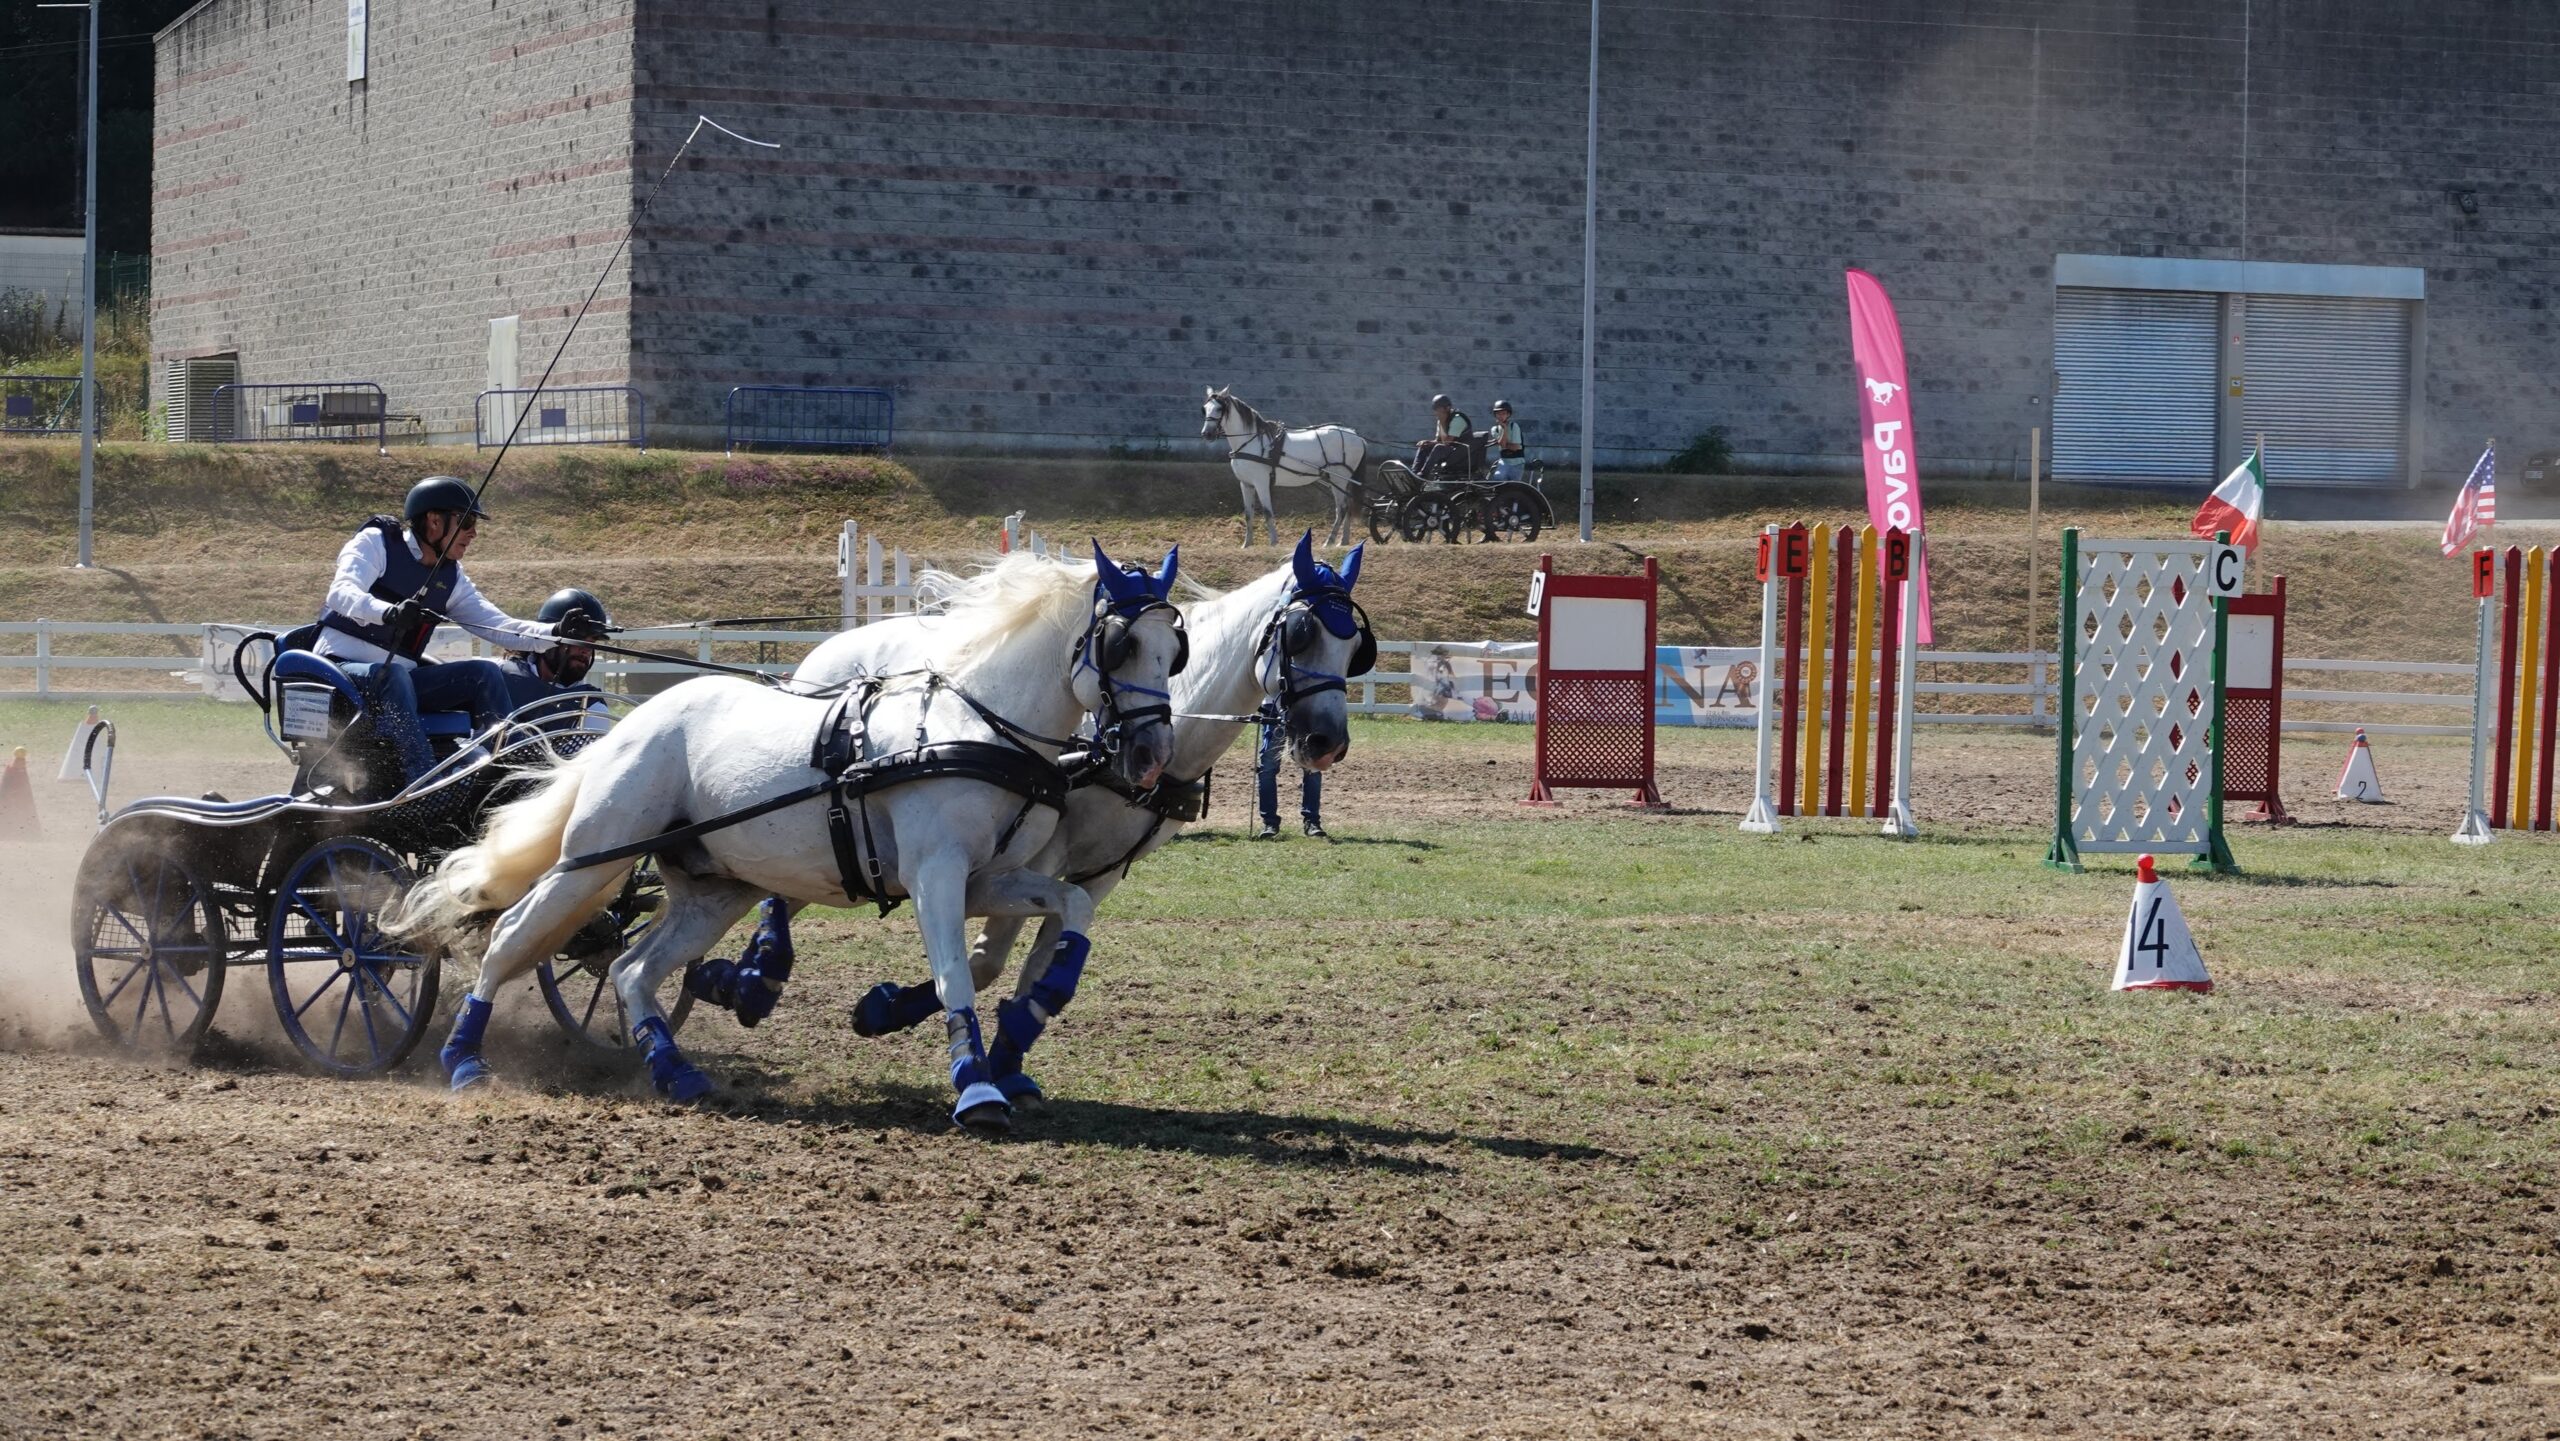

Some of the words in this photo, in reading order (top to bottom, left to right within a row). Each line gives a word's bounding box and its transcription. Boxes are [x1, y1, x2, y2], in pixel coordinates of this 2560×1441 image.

[839, 538, 847, 571] A
[1787, 534, 1803, 573] E
[1890, 539, 1905, 576] B
[2216, 549, 2238, 591] C
[1531, 577, 1541, 609] D
[2480, 556, 2490, 593] F
[2355, 781, 2367, 800] 2
[2128, 897, 2169, 970] 14
